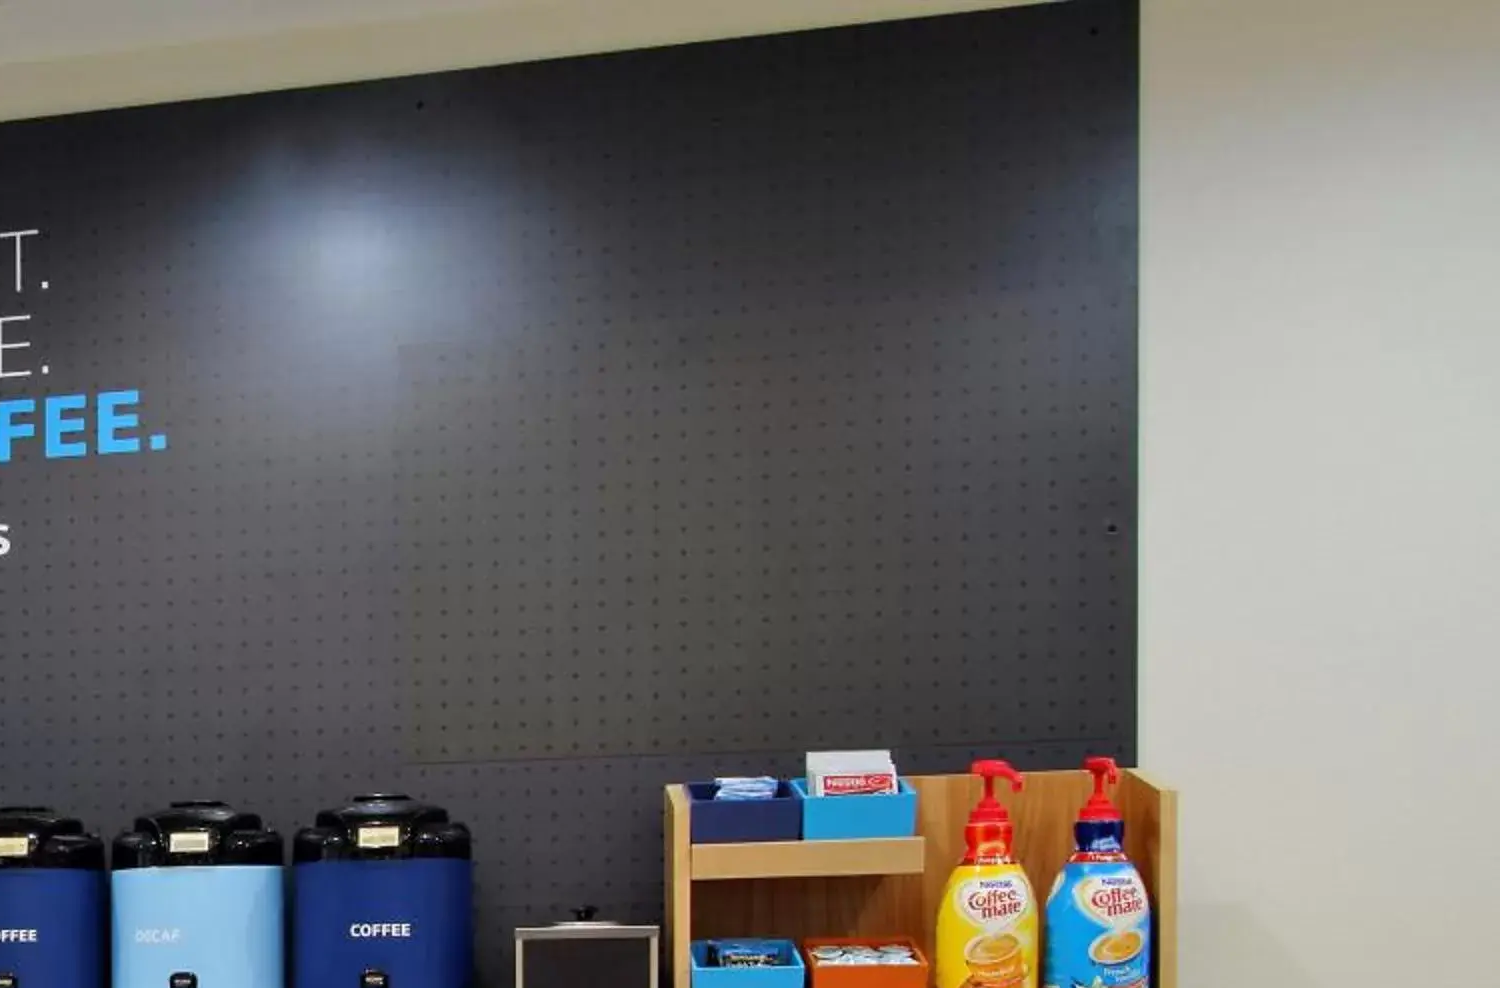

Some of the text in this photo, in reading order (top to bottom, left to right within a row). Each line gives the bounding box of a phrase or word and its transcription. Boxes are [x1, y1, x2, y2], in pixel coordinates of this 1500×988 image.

[967, 889, 1018, 911] Coffee
[981, 901, 1022, 919] mate
[350, 923, 412, 938] COFFEE
